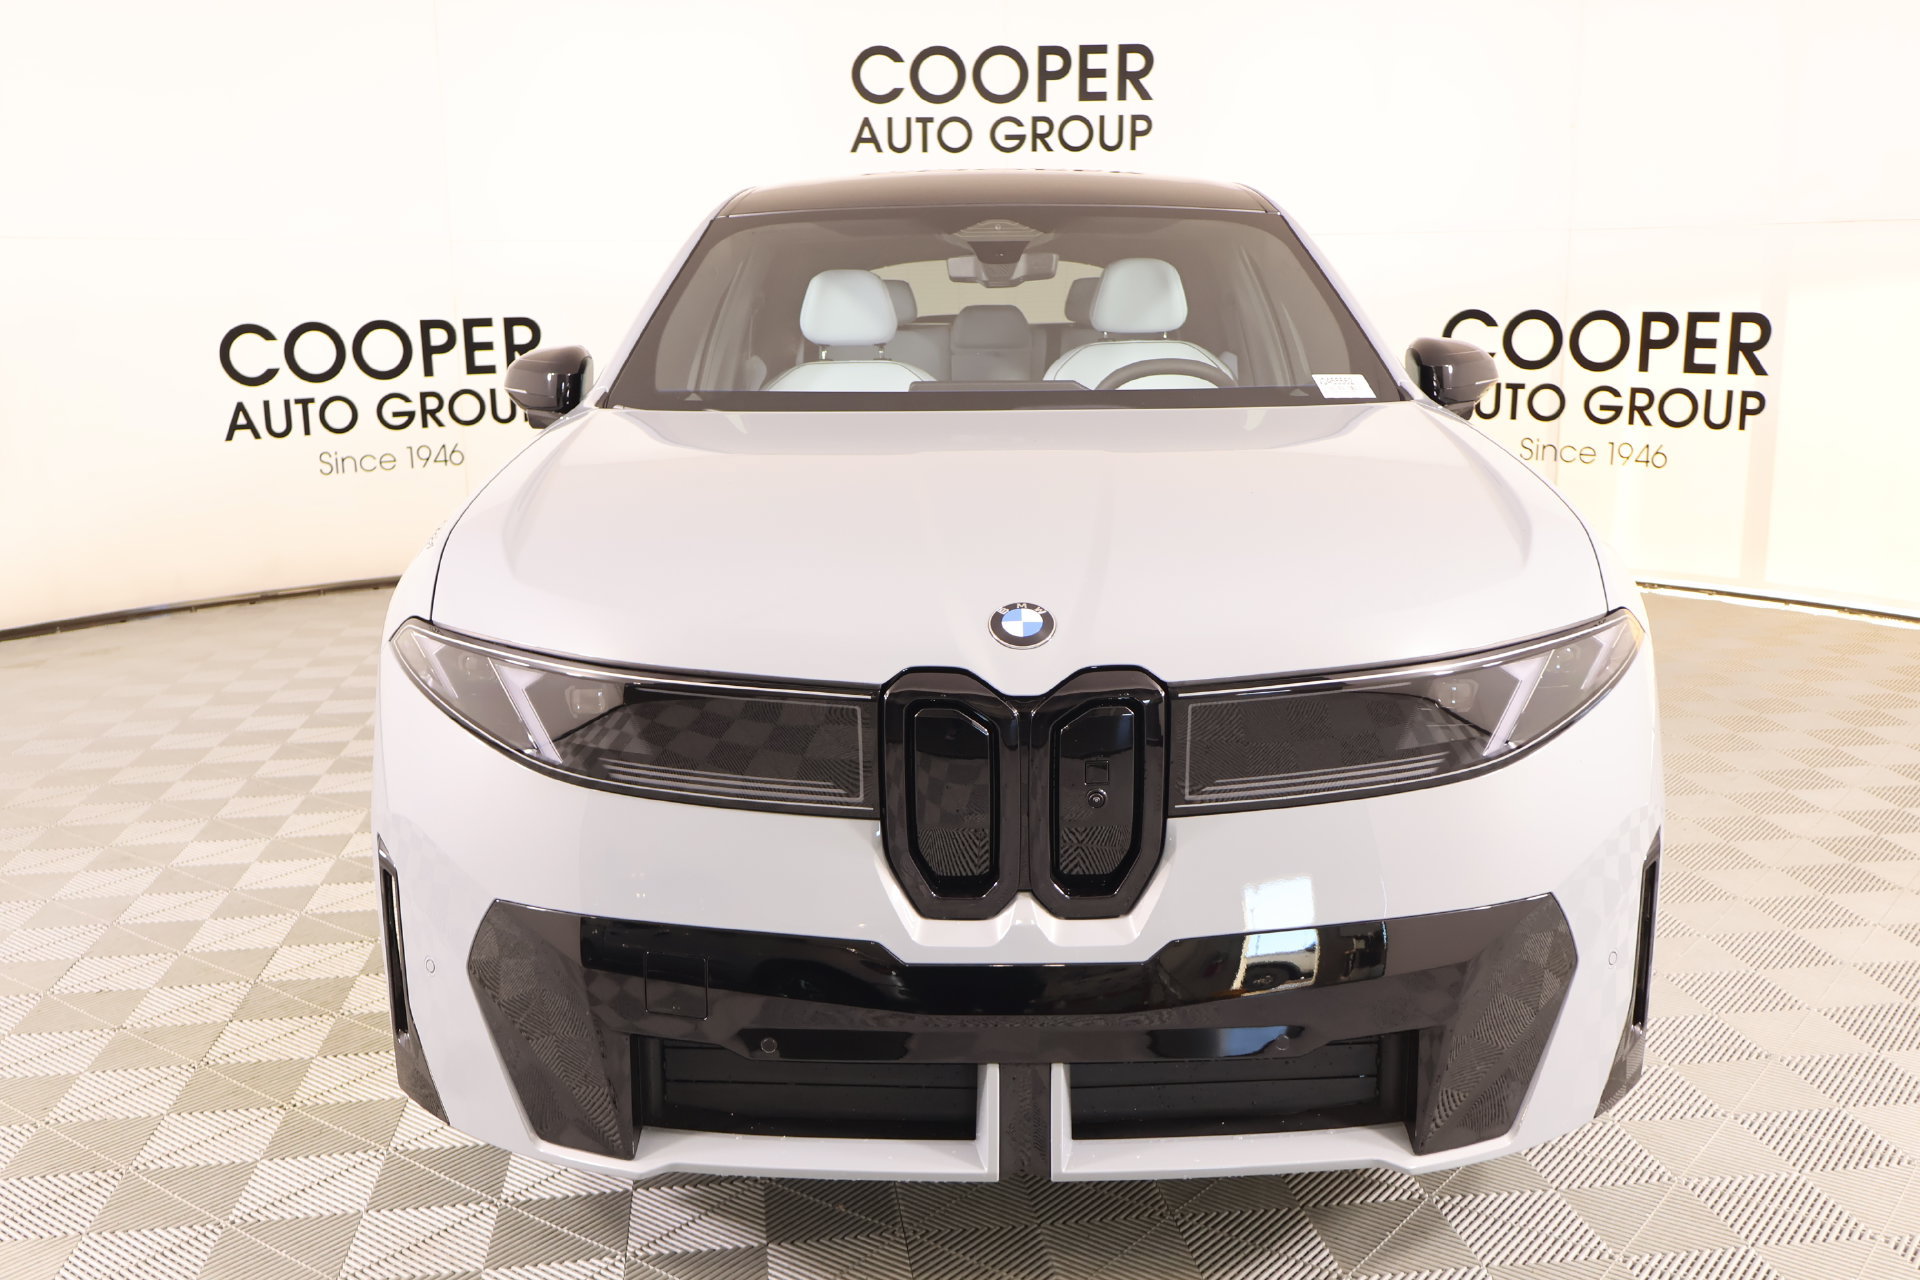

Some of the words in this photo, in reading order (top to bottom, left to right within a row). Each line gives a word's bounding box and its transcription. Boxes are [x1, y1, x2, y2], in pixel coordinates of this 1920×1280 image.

[851, 43, 1155, 104] COOPER
[850, 116, 973, 154] AUTO
[989, 114, 1154, 154] GROUP
[219, 316, 541, 387] COOPER
[225, 395, 358, 442] AUTO
[376, 388, 528, 431] GROU
[1474, 382, 1566, 422] UTO
[1583, 385, 1766, 431] GROUP
[319, 450, 397, 476] Since
[406, 443, 465, 469] 1946
[1519, 437, 1597, 464] Since
[1607, 441, 1668, 469] 1946
[996, 603, 1047, 615] BMW
